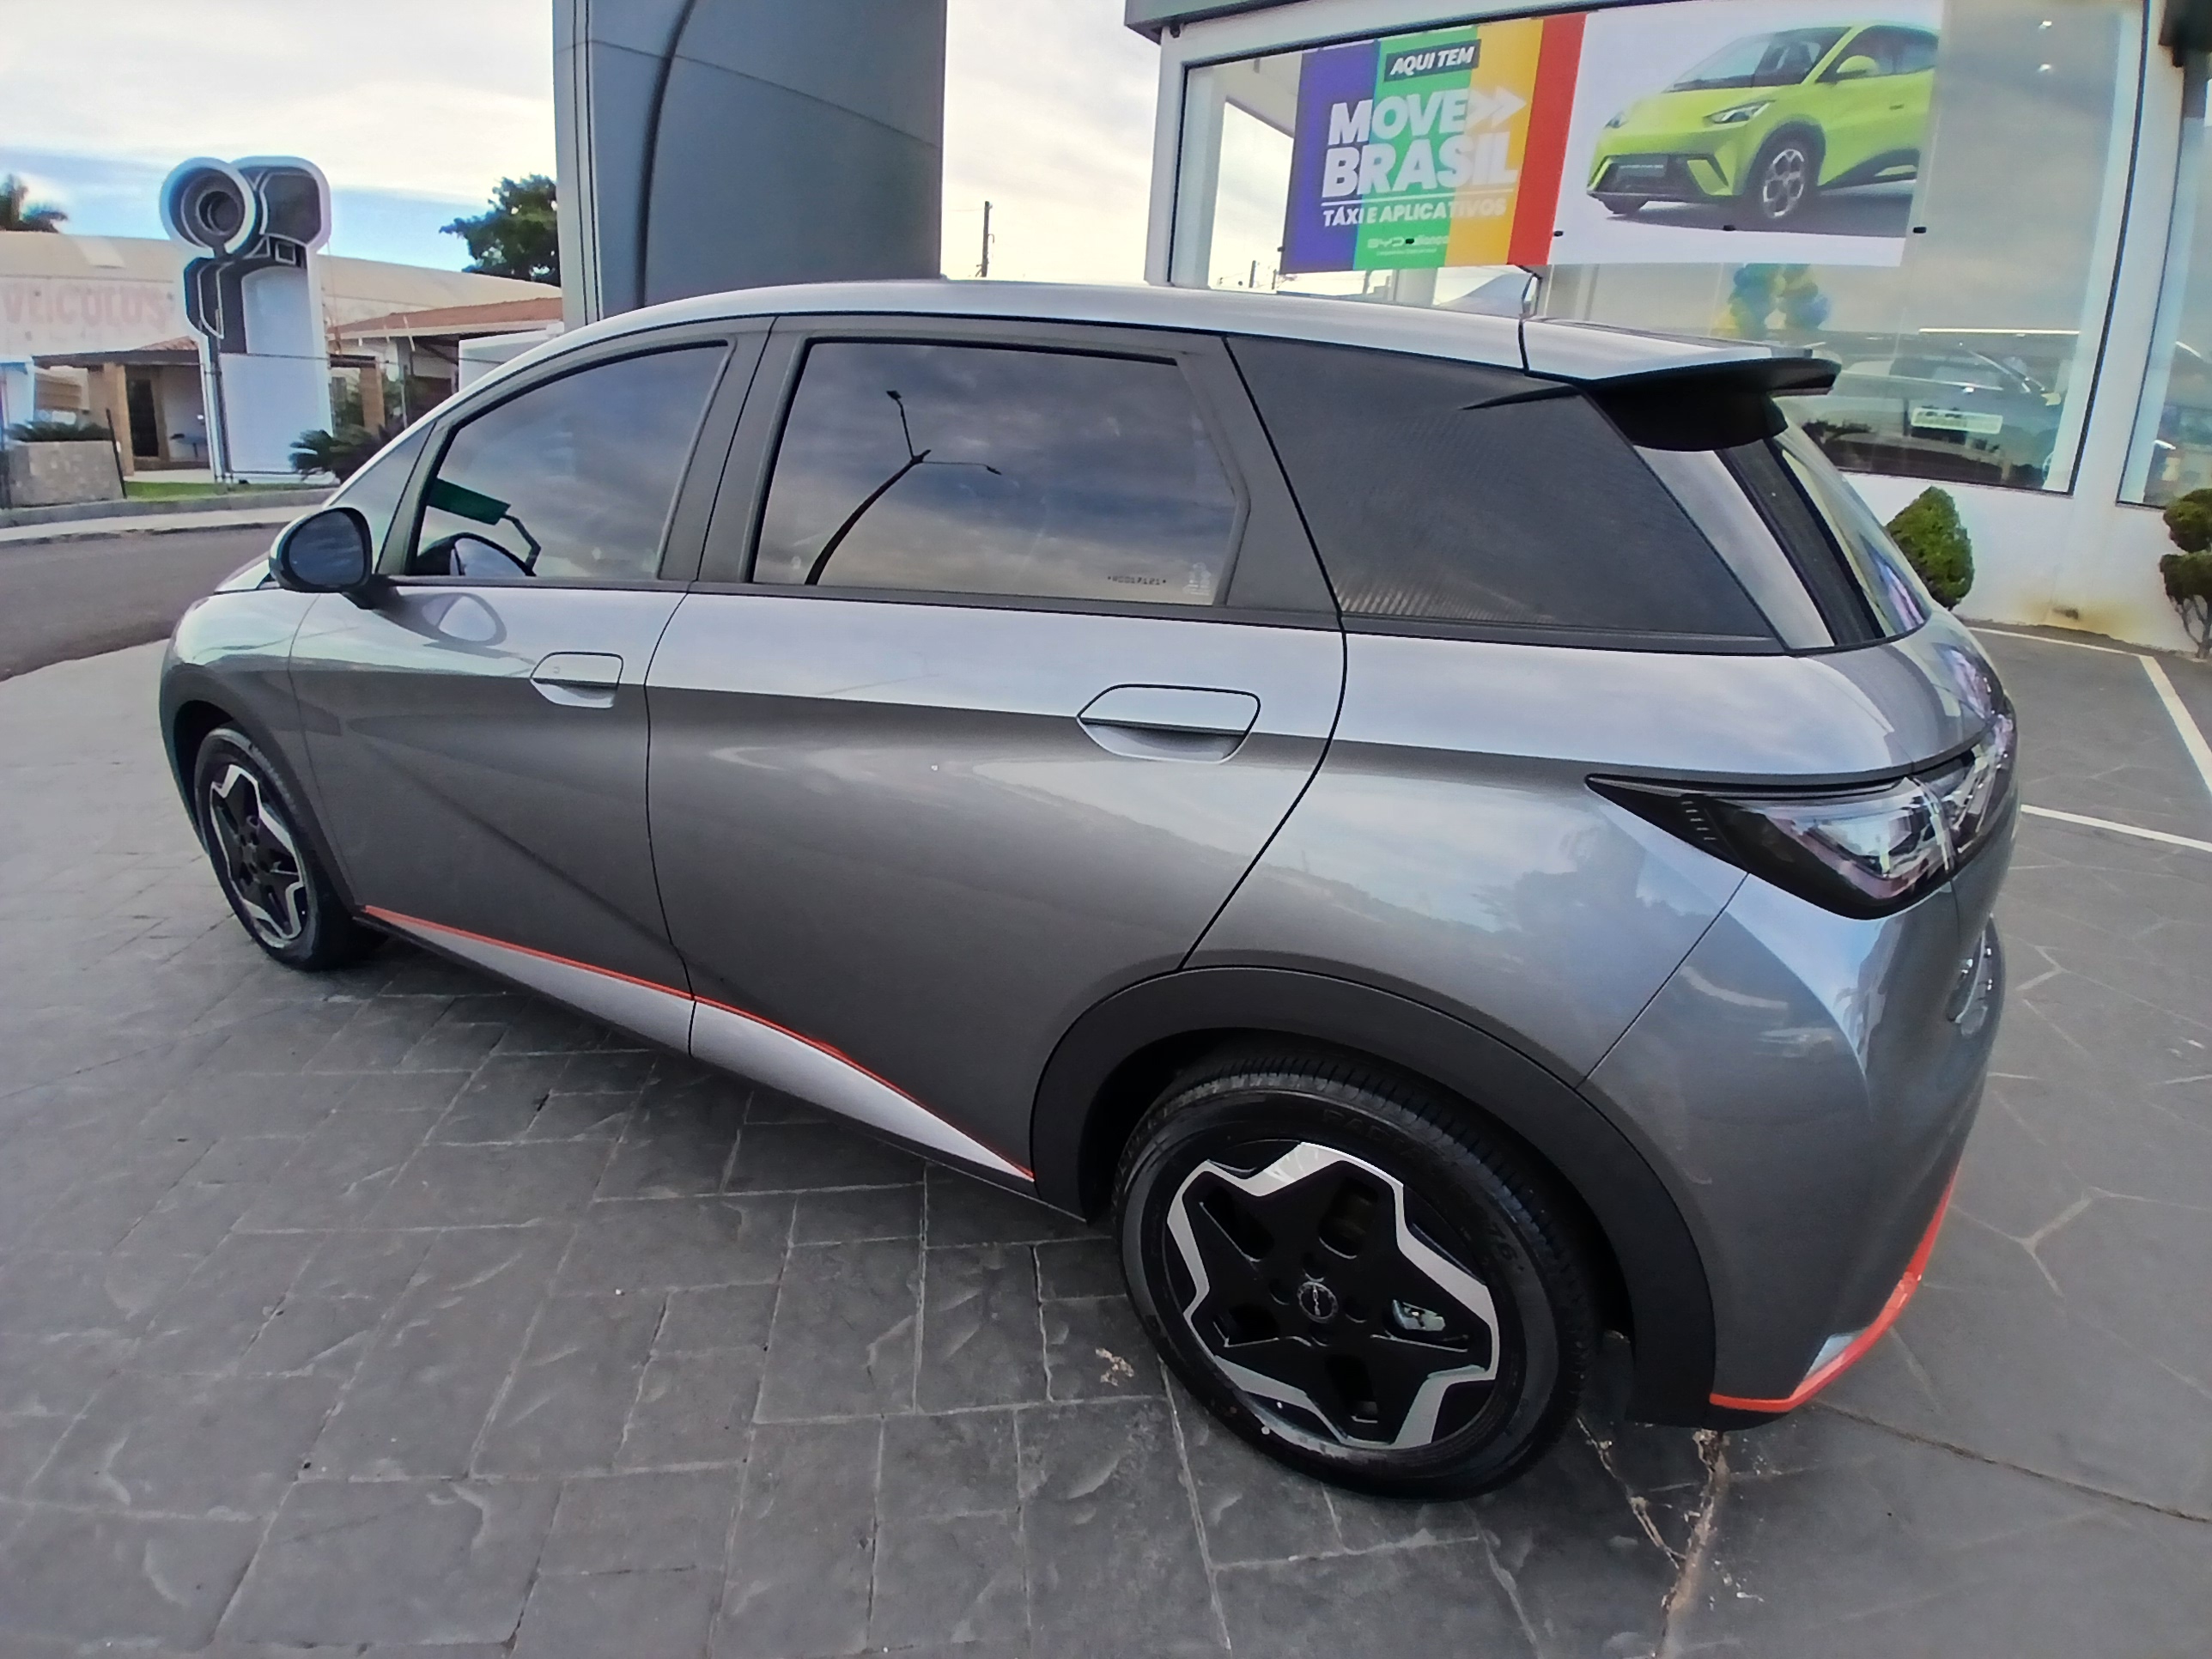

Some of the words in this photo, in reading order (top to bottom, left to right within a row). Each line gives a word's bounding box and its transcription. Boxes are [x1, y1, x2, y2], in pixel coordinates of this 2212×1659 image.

[1389, 52, 1436, 76] AQUI
[1437, 46, 1475, 68] TEM
[1328, 88, 1470, 145] MOVE
[1322, 131, 1518, 197] BRASIL
[1323, 206, 1364, 227] TÁXI
[1366, 207, 1378, 223] E
[1379, 199, 1507, 222] APLICATIVOS
